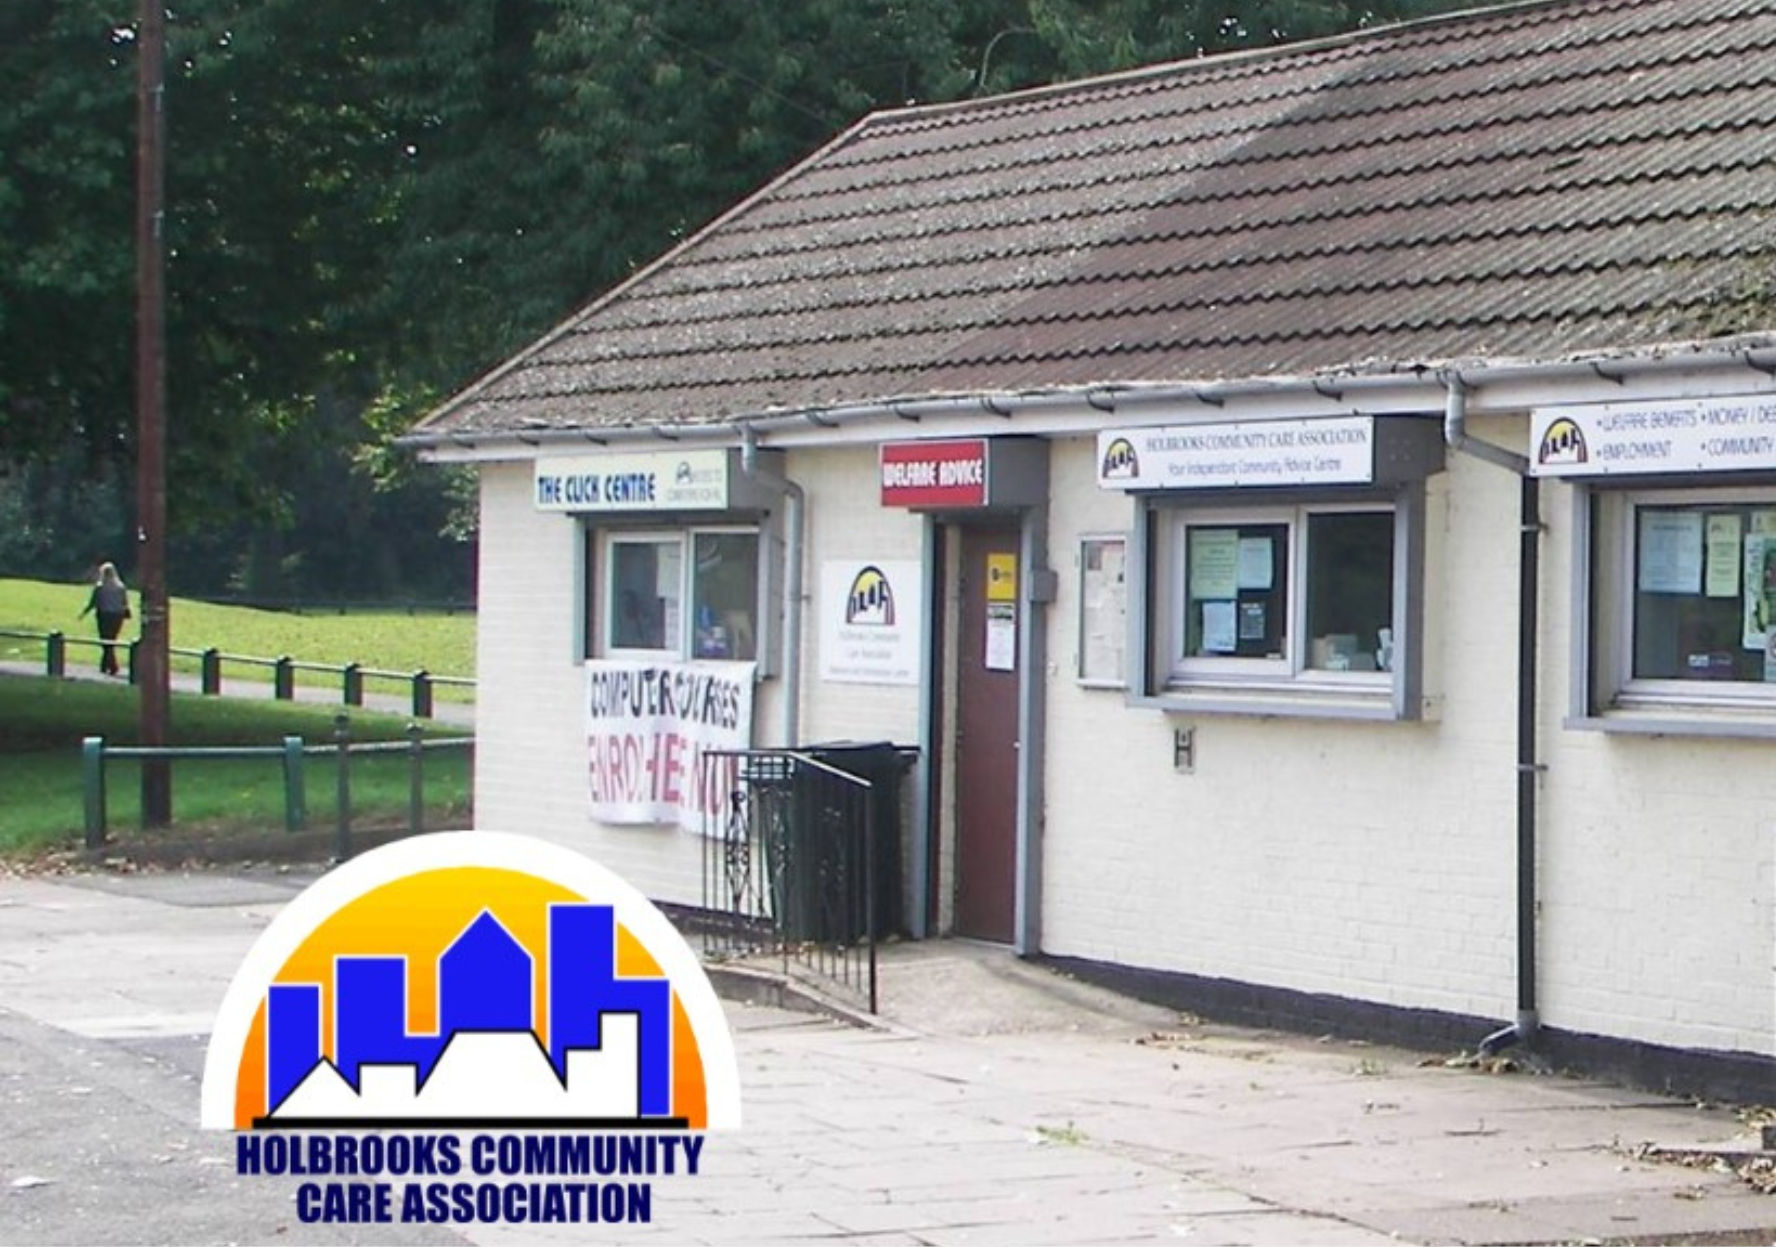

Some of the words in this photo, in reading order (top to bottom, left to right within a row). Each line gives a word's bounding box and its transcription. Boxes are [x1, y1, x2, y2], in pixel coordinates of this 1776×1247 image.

[1707, 406, 1748, 425] MONEY
[1146, 433, 1203, 452] HOLBROOKS
[1204, 431, 1267, 451] COMMUNITY
[1269, 430, 1297, 449] CARE
[1298, 427, 1368, 447] ASSOCIATION
[1602, 439, 1672, 461] EMPLOYMENT
[1707, 436, 1775, 457] COMMUNITY
[883, 461, 937, 488] WELFARE
[939, 458, 983, 486] ADVICE
[538, 476, 561, 504] THE
[565, 474, 601, 504] CLICK
[604, 472, 656, 503] CENTRE
[591, 669, 675, 719] COMPUTER
